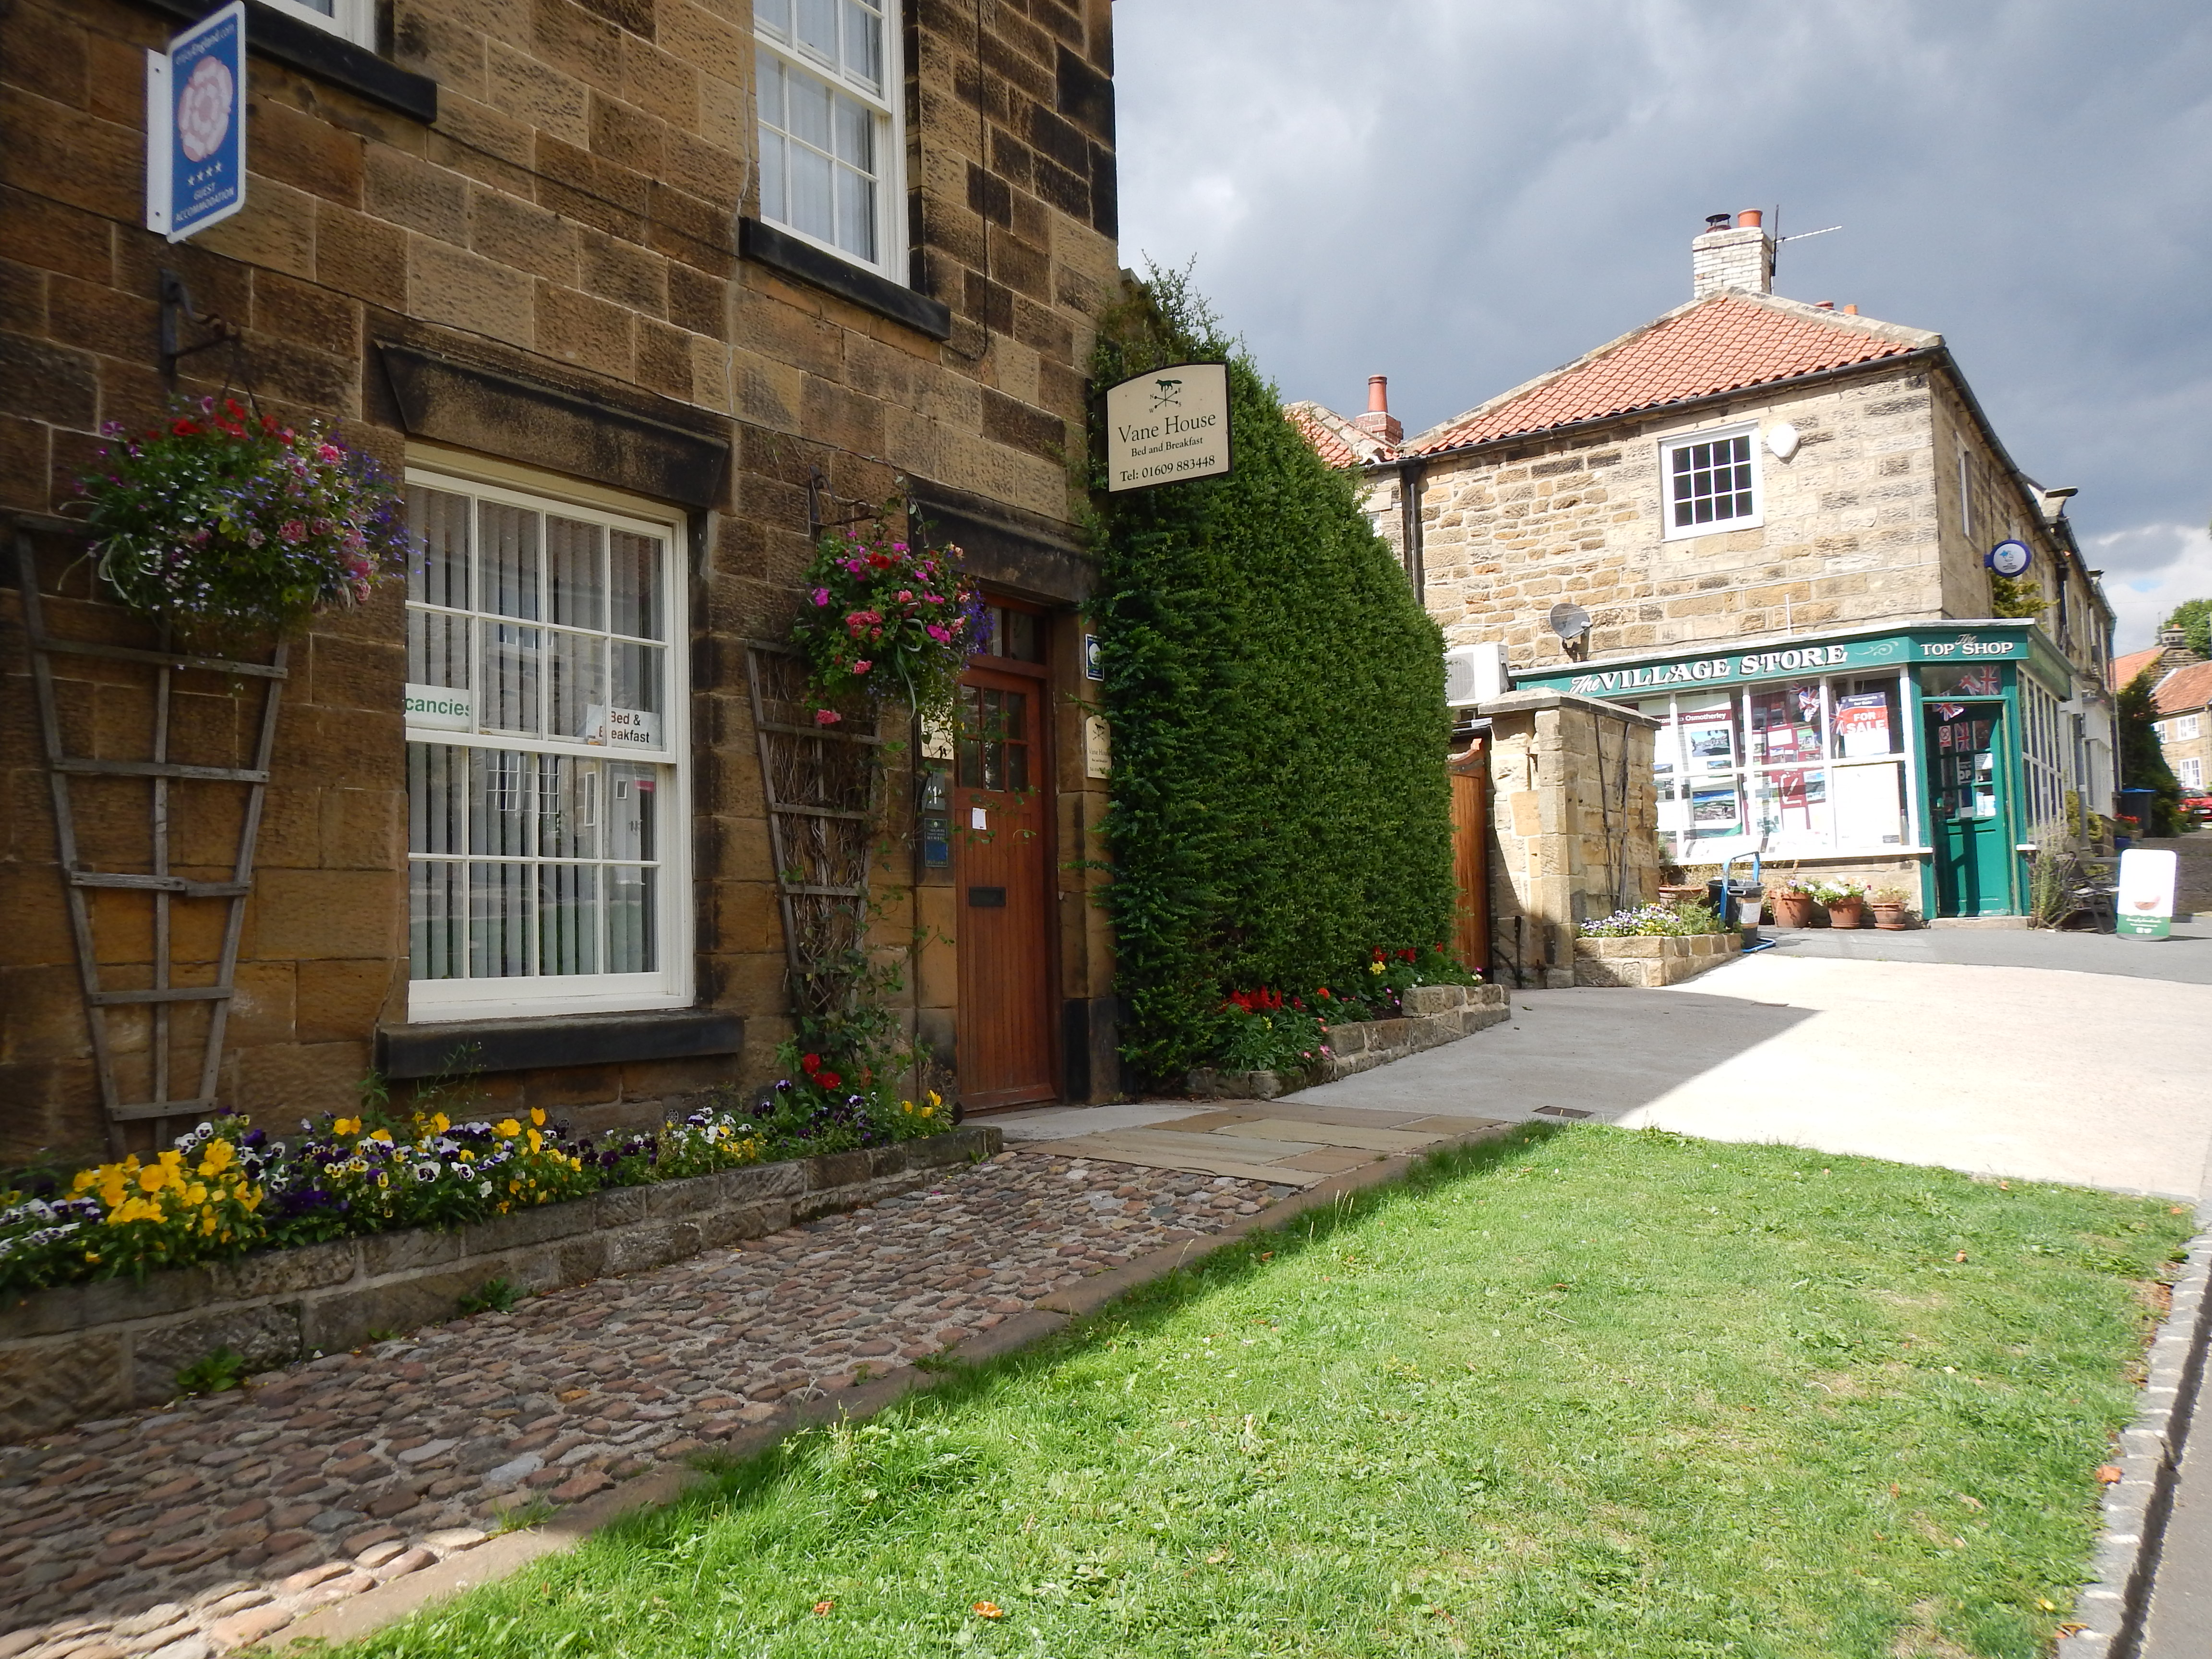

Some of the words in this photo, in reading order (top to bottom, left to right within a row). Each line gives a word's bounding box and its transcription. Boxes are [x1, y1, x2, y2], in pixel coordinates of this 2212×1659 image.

[1118, 425, 1159, 443] Vane
[1165, 414, 1216, 435] House
[1131, 446, 1146, 457] Bed
[1149, 443, 1163, 454] and
[1166, 436, 1203, 450] Breakfast
[1120, 469, 1139, 481] Tel:
[1142, 463, 1174, 478] 01609
[1177, 455, 1215, 471] 883448
[1955, 633, 1977, 645] The
[1920, 643, 1955, 656] TOP
[1962, 642, 2014, 655] SHOP
[1569, 675, 1600, 694] The
[1597, 659, 1731, 690] VILLAGE
[1739, 644, 1848, 676] STORE
[406, 698, 469, 717] cancies
[633, 714, 641, 726] &
[1685, 713, 1726, 721] Osmotherley
[1853, 711, 1875, 721] FOR
[599, 726, 649, 743] Beakfast
[1846, 720, 1886, 734] SALE
